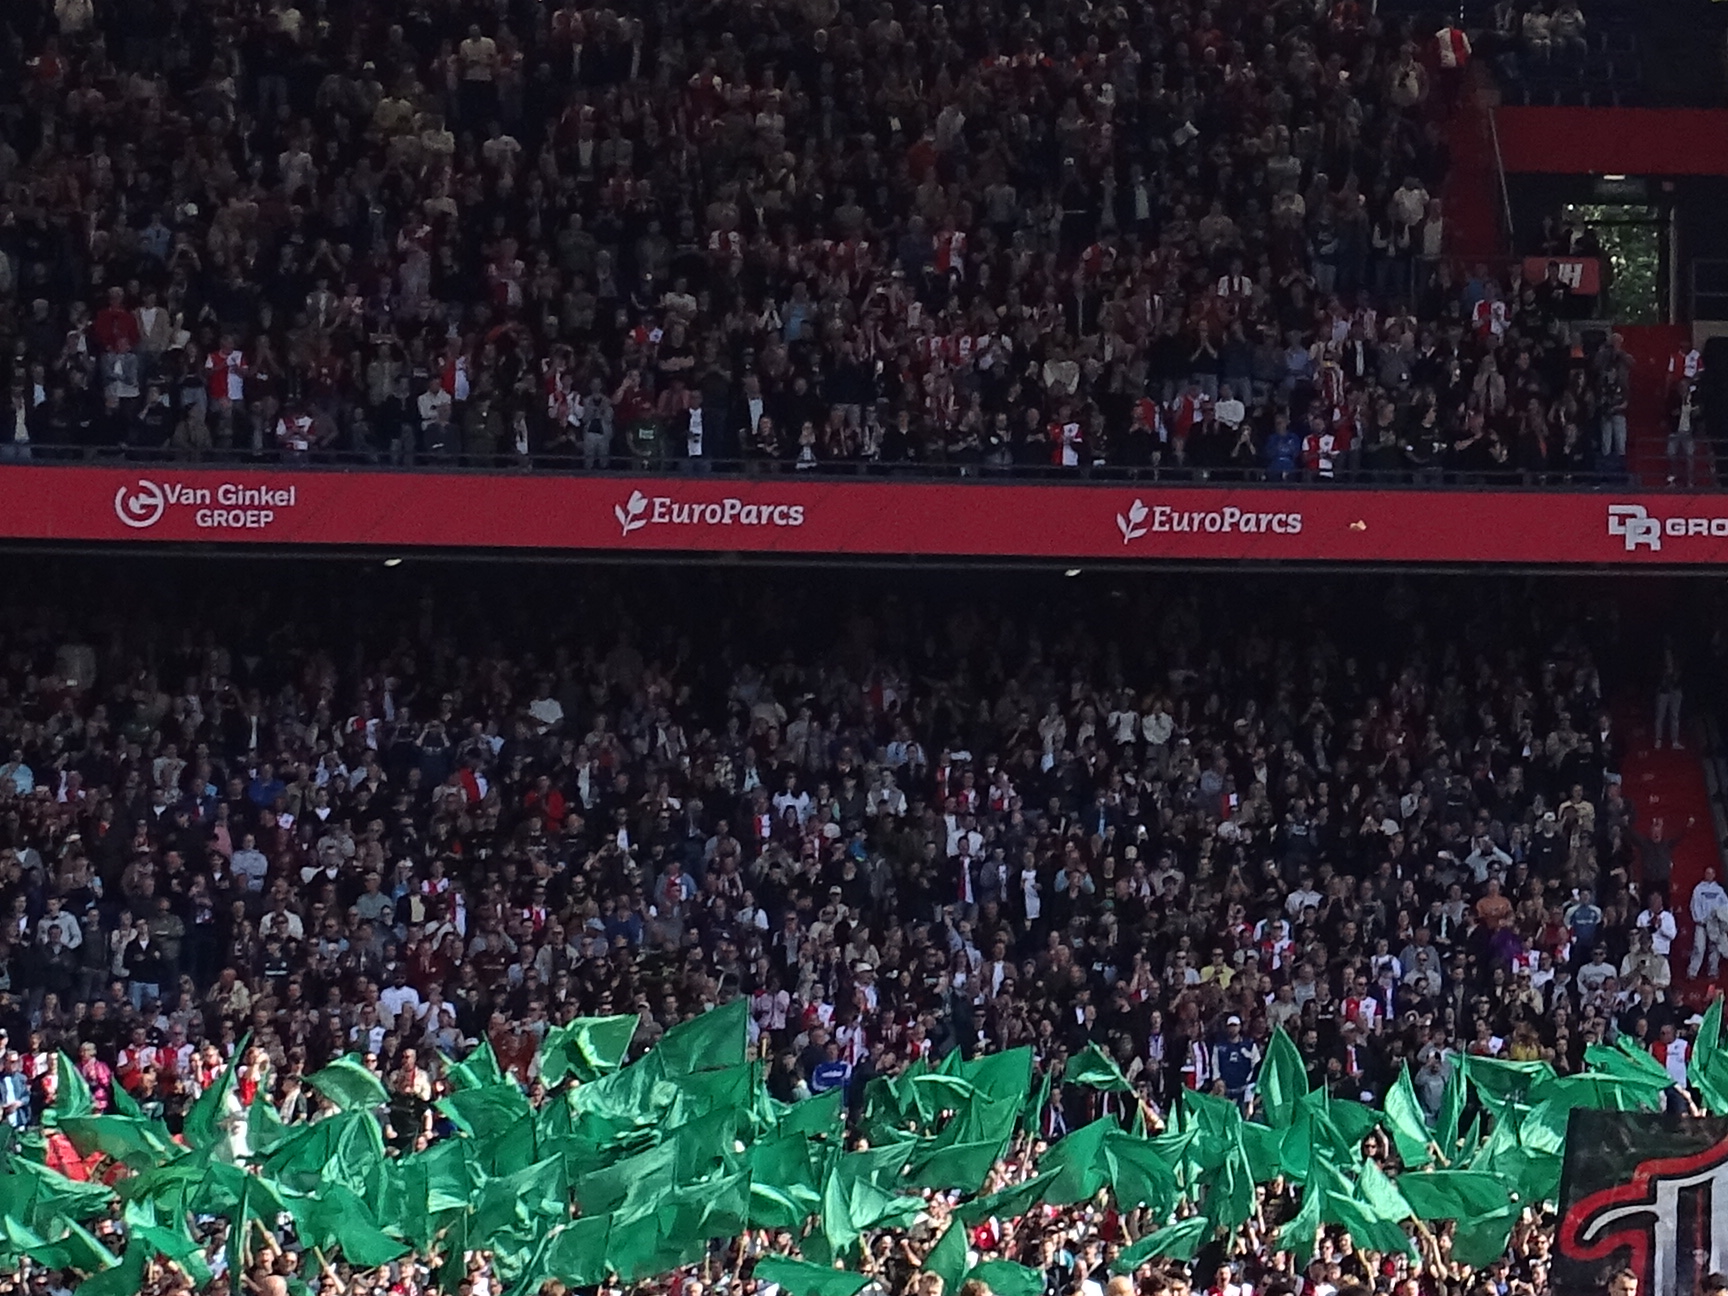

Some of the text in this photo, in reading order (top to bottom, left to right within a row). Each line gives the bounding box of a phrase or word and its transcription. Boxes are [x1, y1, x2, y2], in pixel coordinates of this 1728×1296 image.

[163, 483, 296, 507] Van Ginkel
[195, 508, 274, 528] GROEP
[650, 497, 804, 526] EuroParcs
[1151, 506, 1303, 535] EuroParcs
